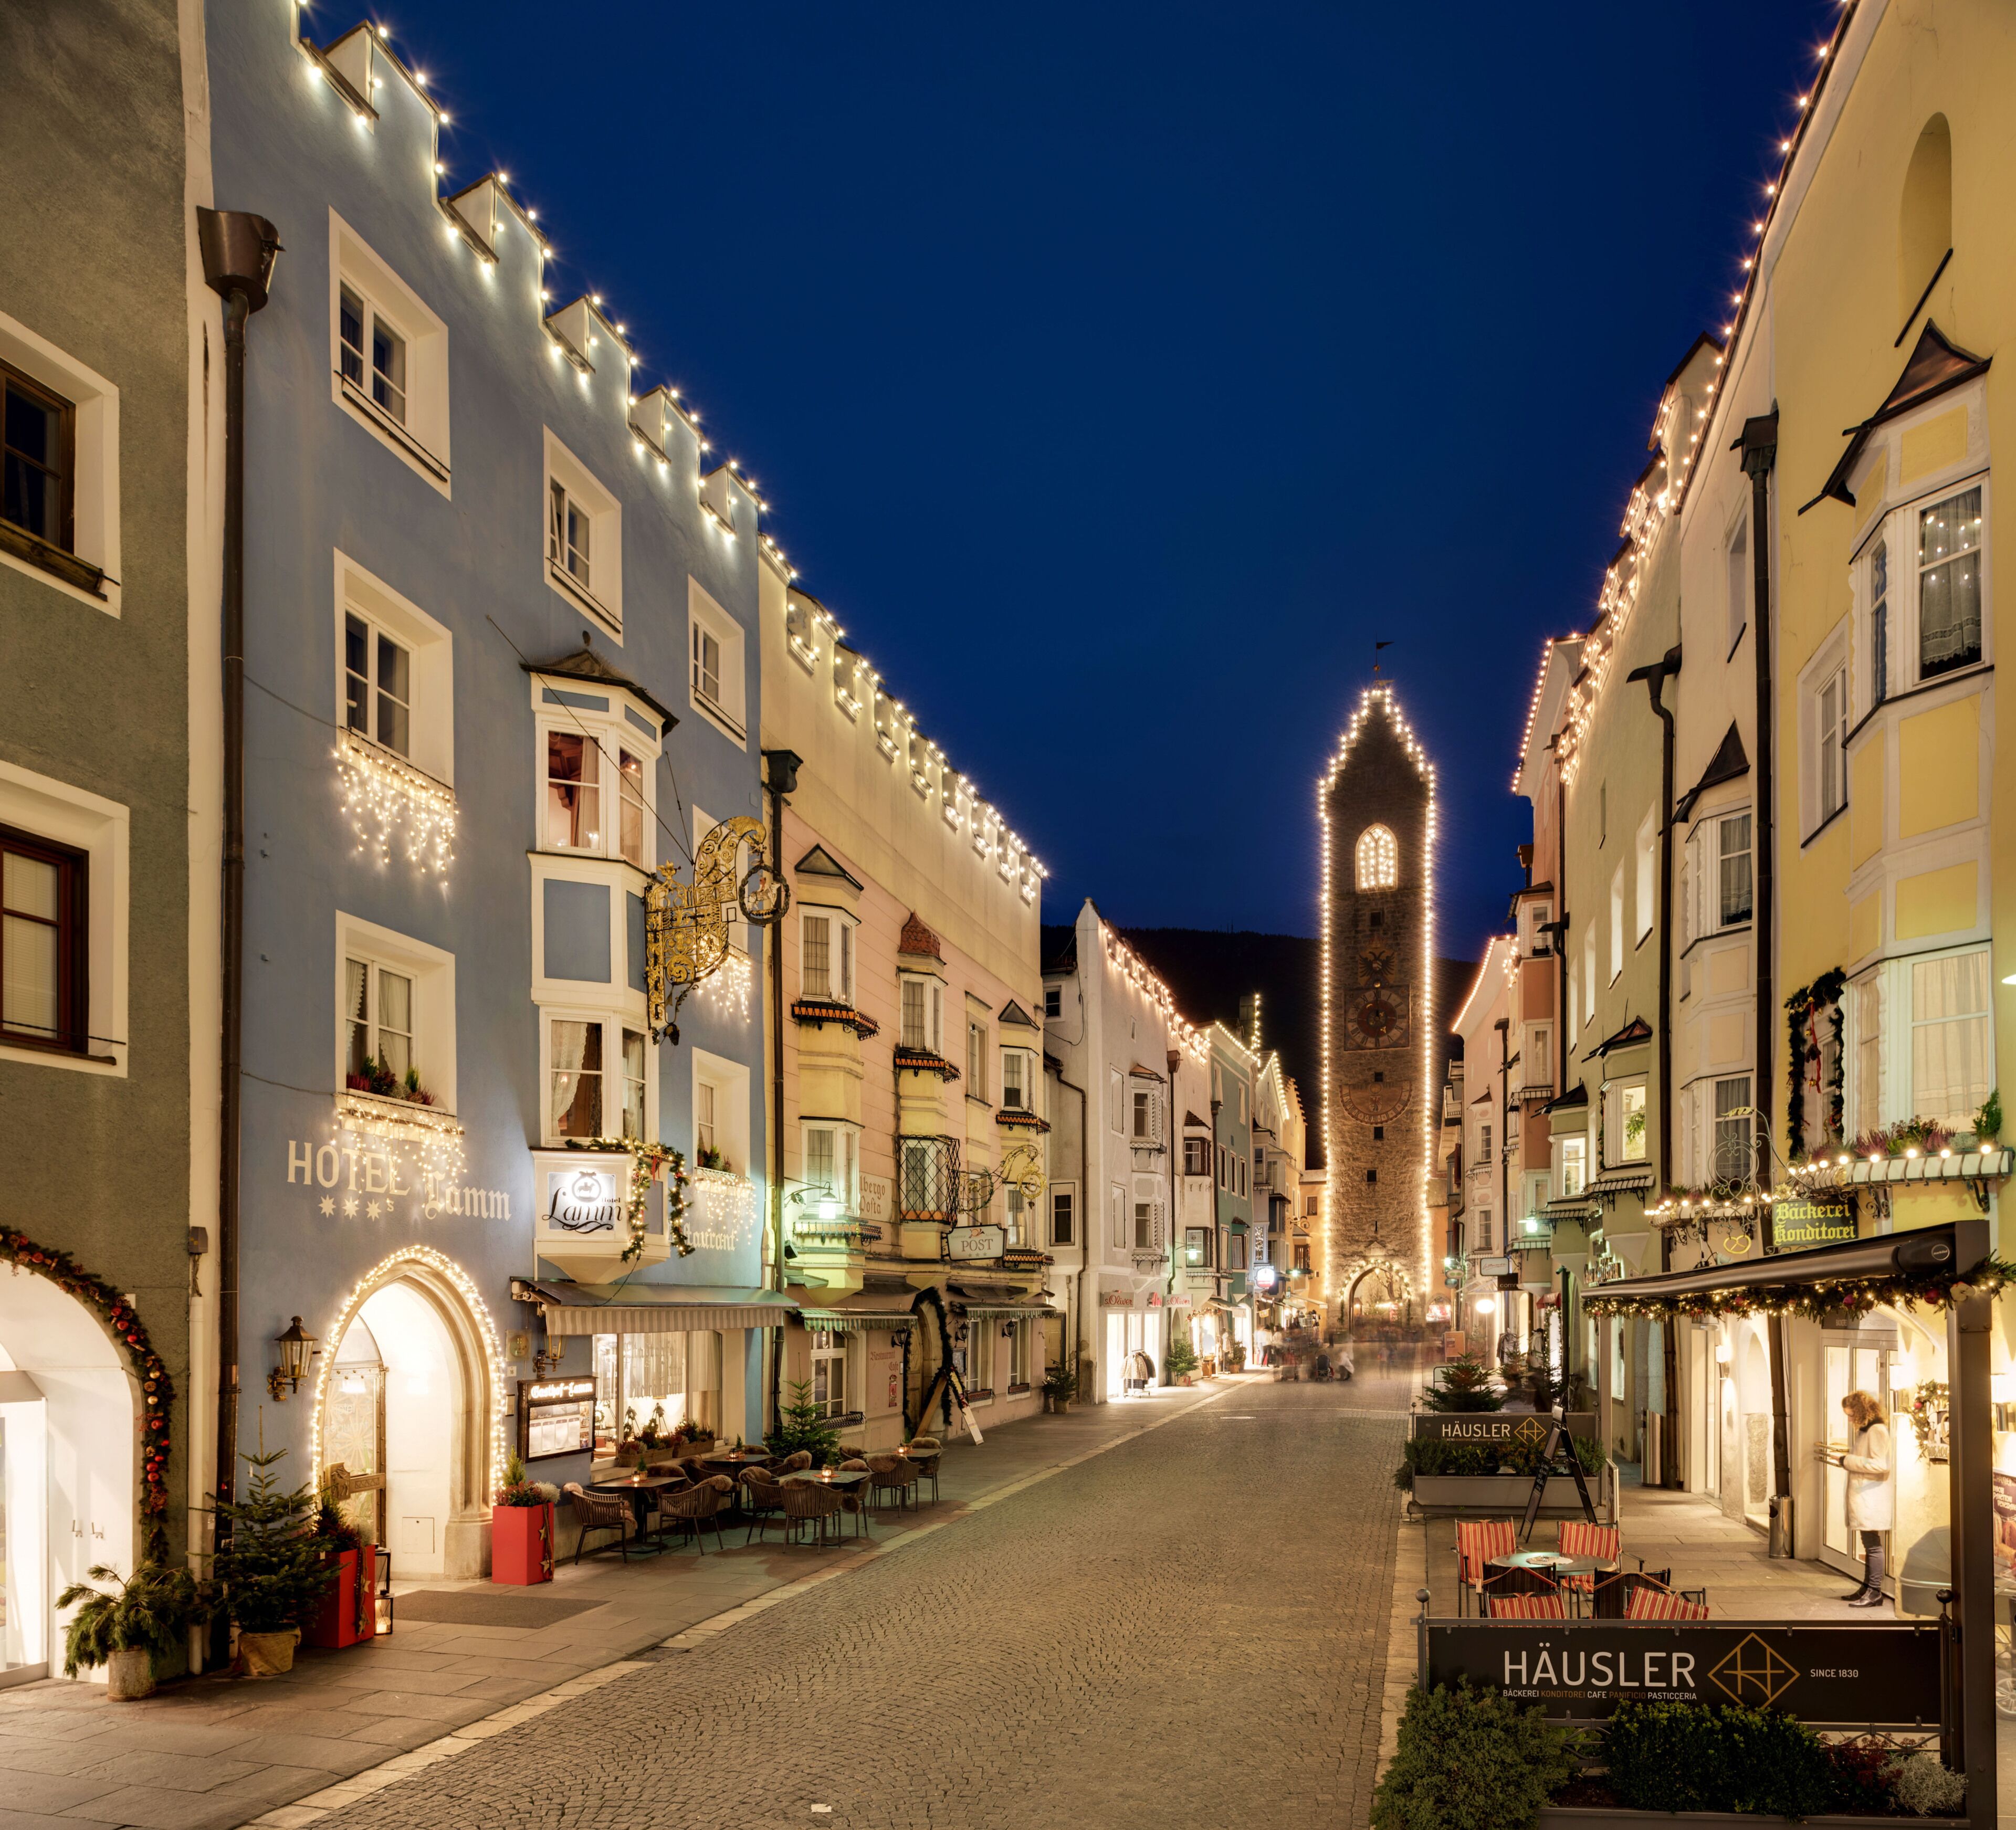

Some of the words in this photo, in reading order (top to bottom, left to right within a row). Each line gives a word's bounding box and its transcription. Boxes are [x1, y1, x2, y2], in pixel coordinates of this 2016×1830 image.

[287, 1140, 411, 1196] HOTEL
[424, 1171, 512, 1222] Lamm
[860, 1175, 885, 1200] lbergo
[542, 1186, 623, 1233] Lamm
[1776, 1200, 1851, 1224] Bäckerei
[668, 1222, 736, 1251] staurant
[961, 1238, 994, 1252] POST
[1773, 1220, 1856, 1246] Konditorei
[1104, 1294, 1132, 1306] s.Oliver
[1167, 1296, 1190, 1306] s.Oliver
[1442, 1421, 1510, 1437] HÄUSLER
[1504, 1642, 1695, 1687] HÄUSLER
[1810, 1669, 1836, 1677] SINCE
[1839, 1669, 1858, 1678] 1830
[1503, 1688, 1539, 1697] BÄCKEREI
[1541, 1690, 1585, 1698] KONDITOREI
[1647, 1691, 1697, 1700] PASTICCERIA
